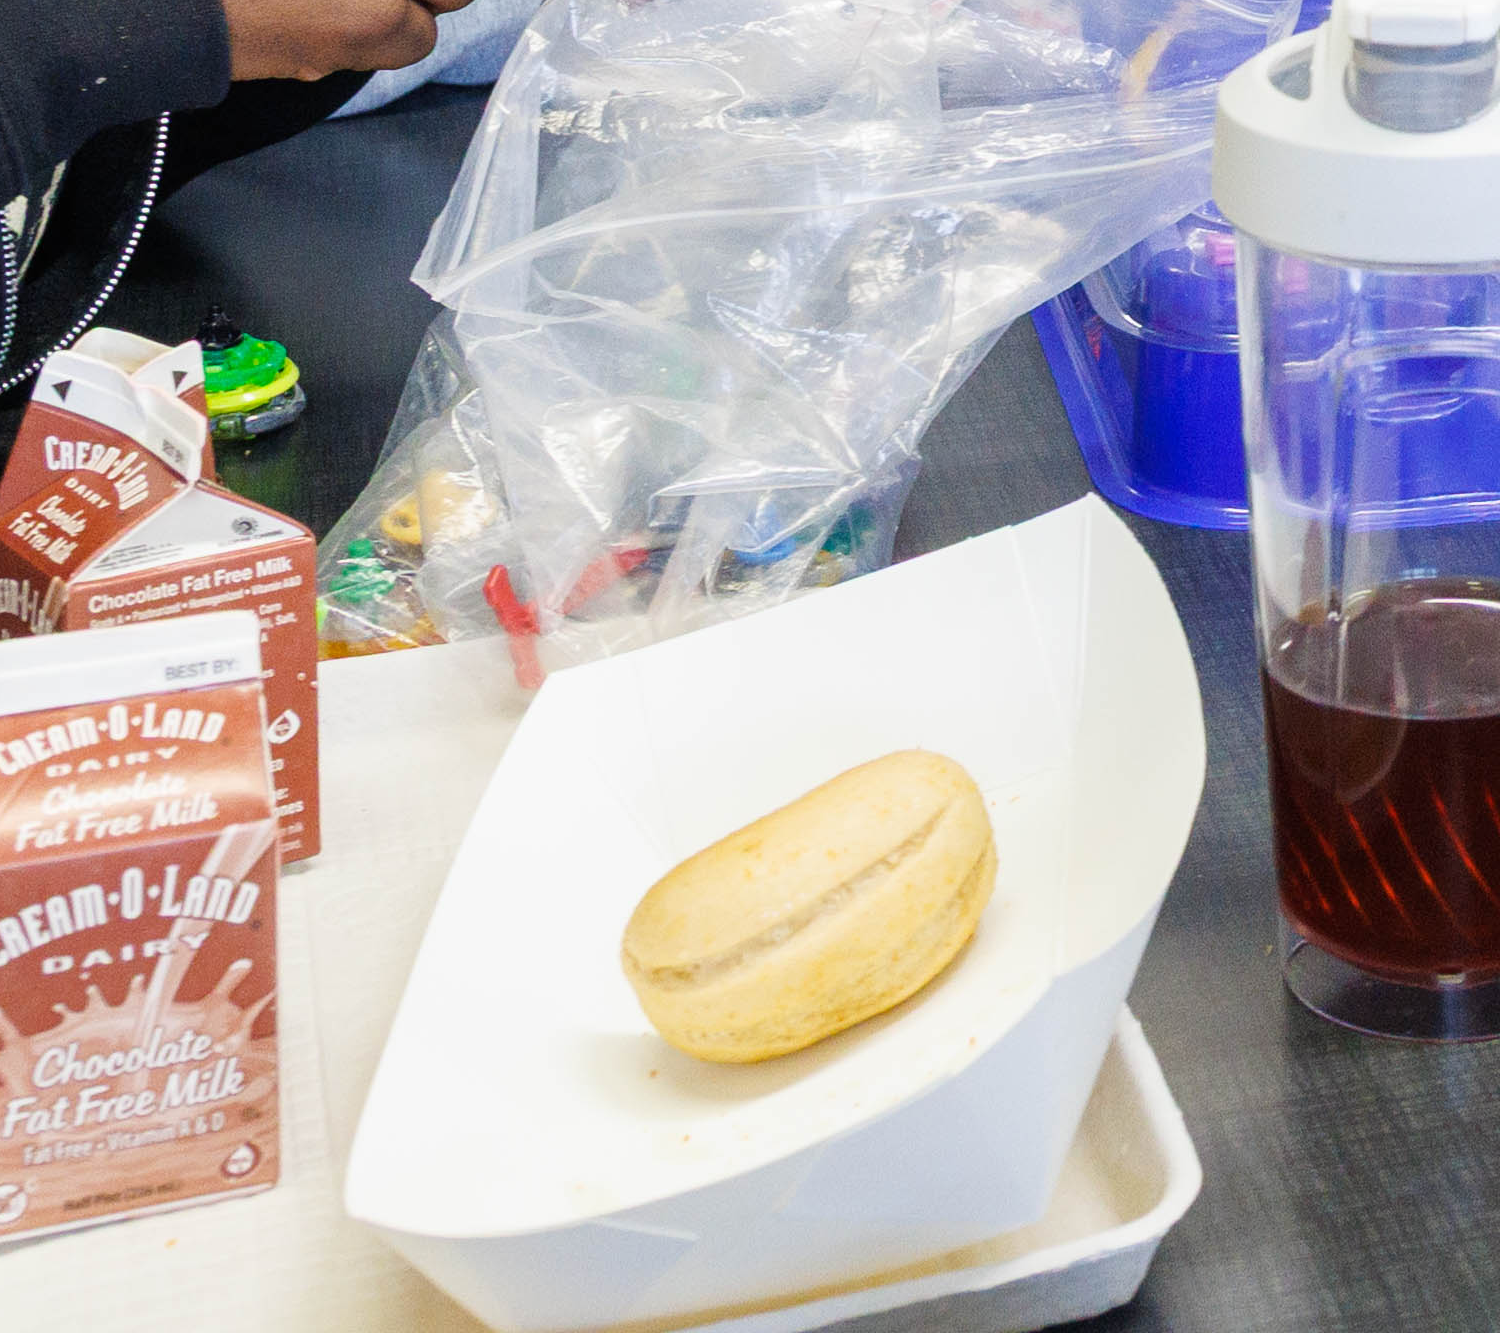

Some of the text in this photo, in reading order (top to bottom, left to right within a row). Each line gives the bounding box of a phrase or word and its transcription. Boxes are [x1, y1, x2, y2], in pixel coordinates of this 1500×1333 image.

[64, 476, 111, 509] DAIRY
[88, 556, 292, 613] Chocolate Fat Free Milk
[165, 658, 240, 681] BEST BY:
[45, 746, 180, 778] DAIRY
[41, 771, 188, 817] Chocolate
[14, 793, 219, 852] Fat Free Milk
[42, 931, 211, 975] DAIRY
[32, 1027, 214, 1089] Chocolate
[2, 1056, 245, 1139] Fat Free Milk
[23, 1145, 52, 1167] Fat
[53, 1140, 93, 1160] Free
[107, 1124, 176, 1152] Vitamin
[211, 1111, 226, 1132] D
